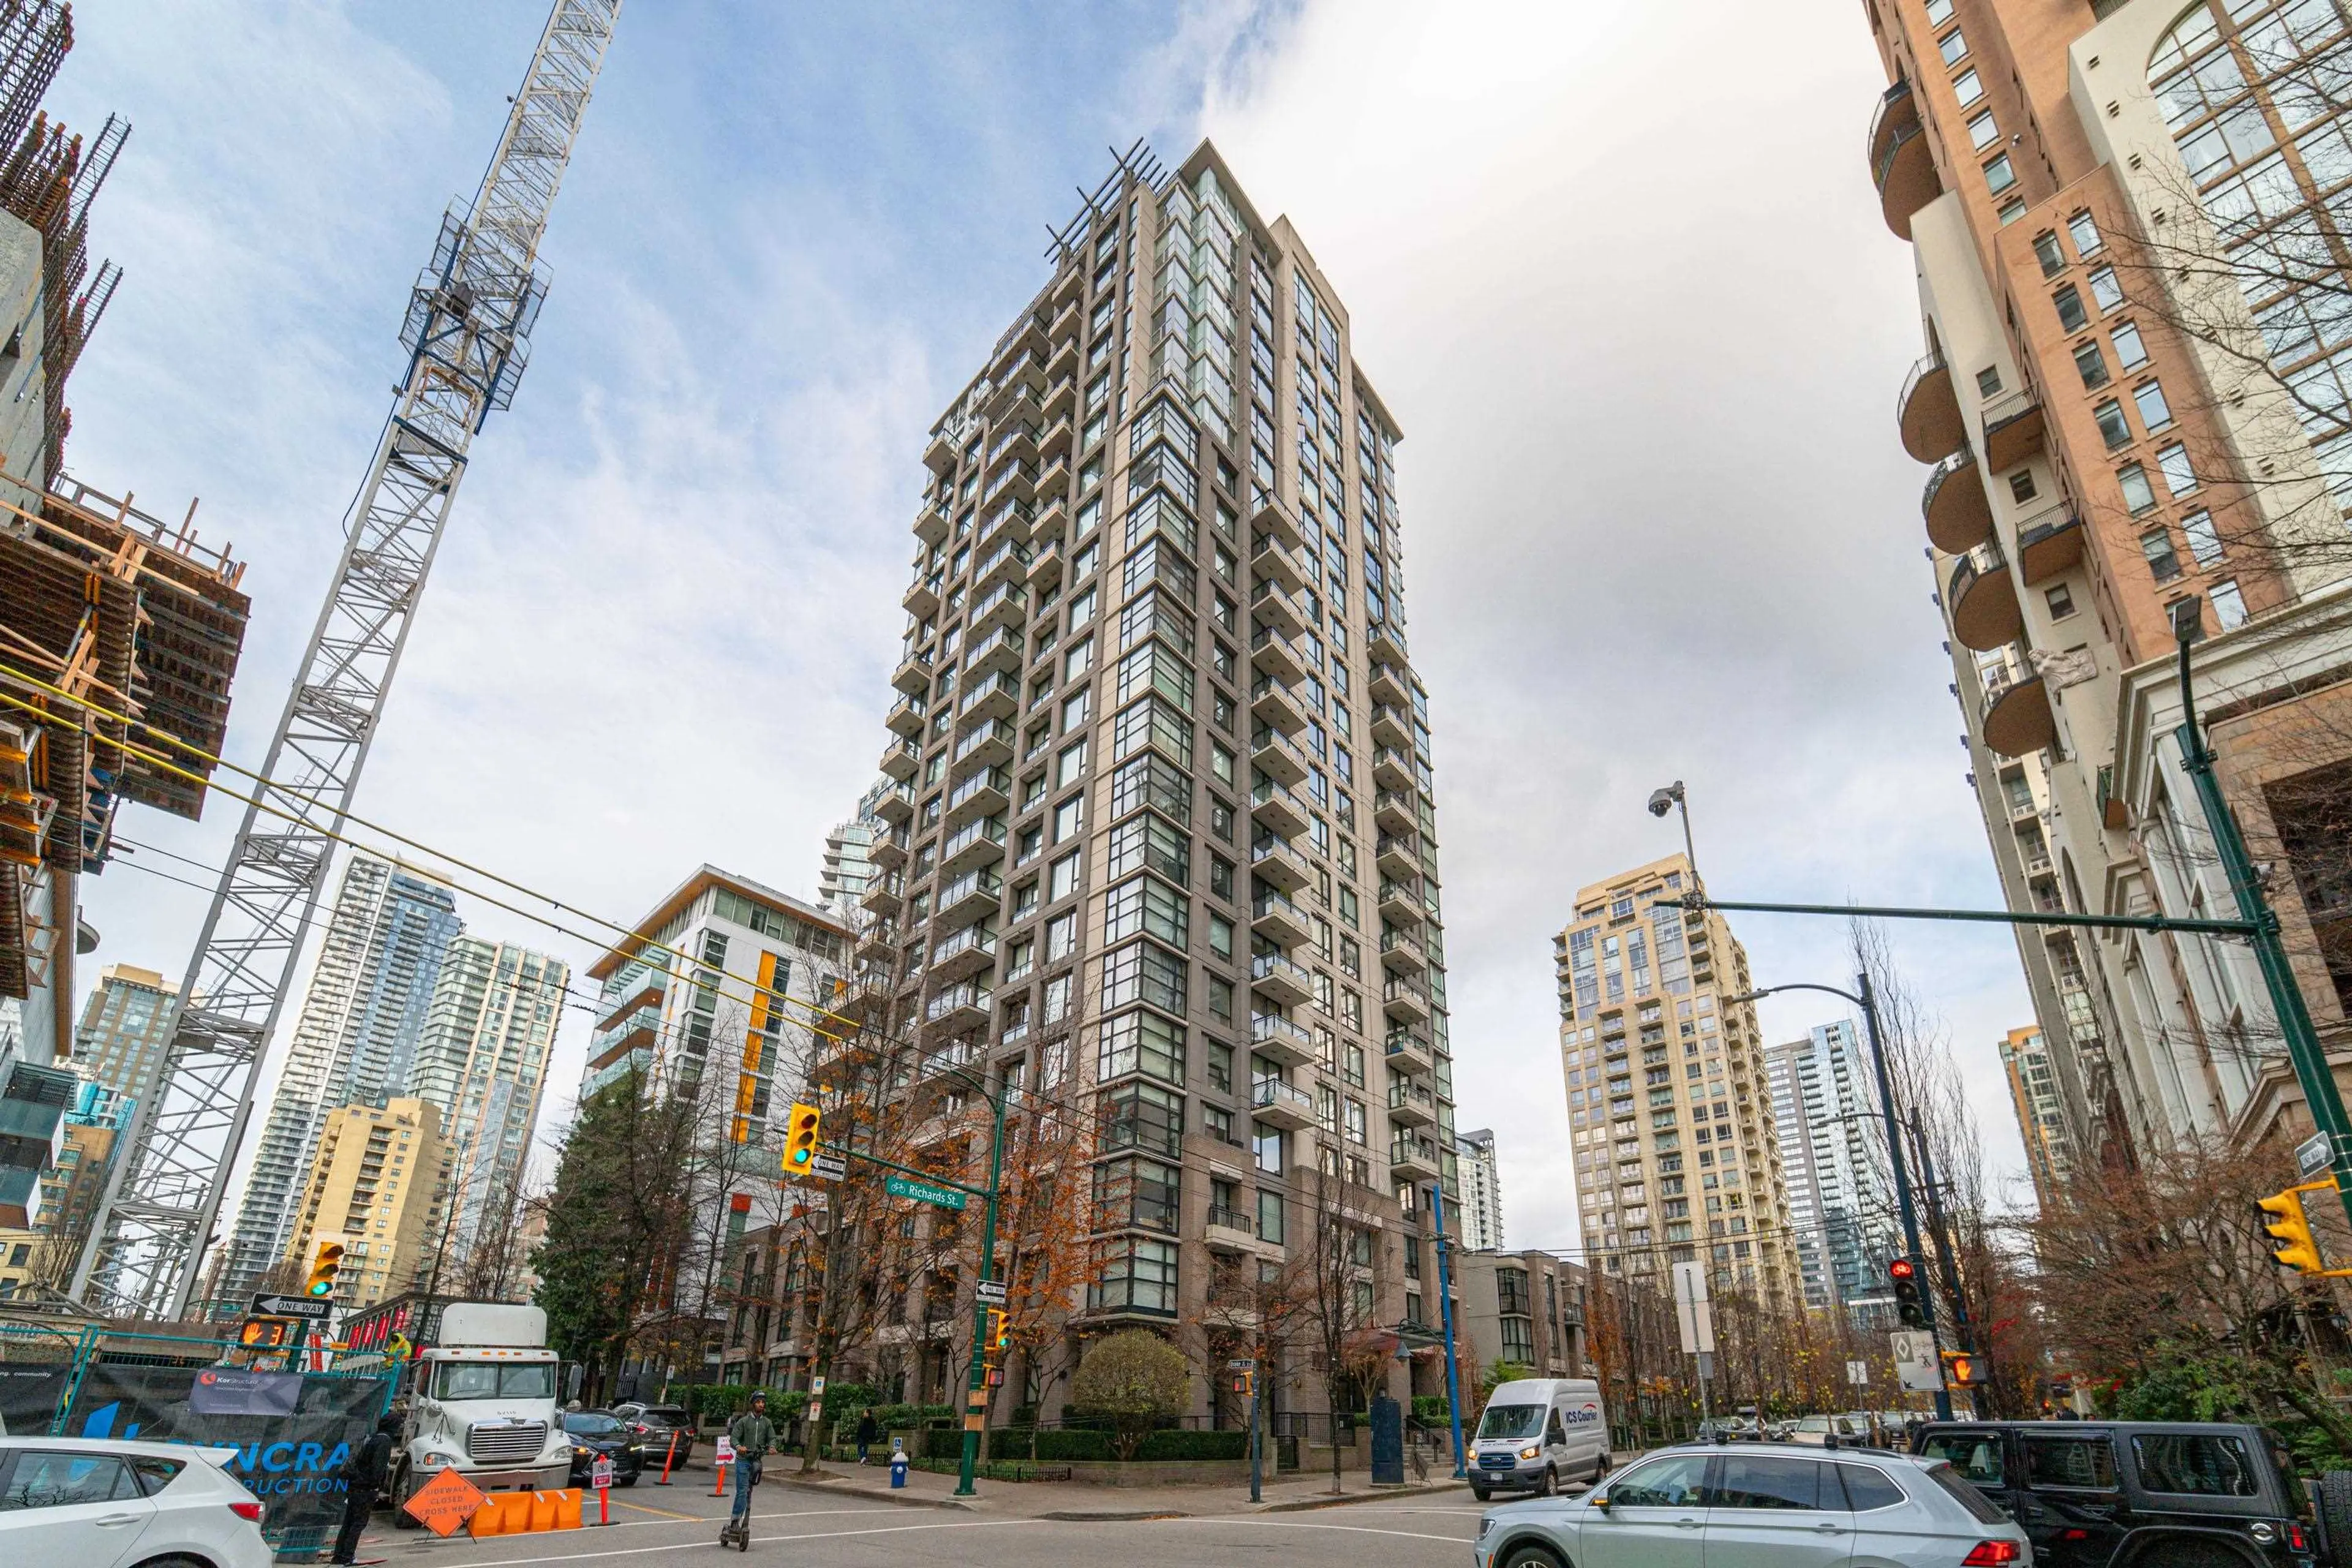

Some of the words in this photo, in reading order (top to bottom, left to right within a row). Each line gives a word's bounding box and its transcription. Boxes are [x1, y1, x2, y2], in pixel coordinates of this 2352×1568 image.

[909, 1185, 945, 1202] Richards
[947, 1194, 959, 1205] St.
[277, 1302, 298, 1310] ONE
[302, 1303, 323, 1313] WAY
[268, 1325, 283, 1345] 3
[1566, 1411, 1577, 1423] ICS
[1578, 1410, 1597, 1422] Courier
[167, 1439, 350, 1472] NCRA
[243, 1478, 349, 1494] RUCTION
[425, 1485, 468, 1494] SIDEWALK
[431, 1496, 463, 1505] CLOSED
[419, 1507, 447, 1517] CROSS
